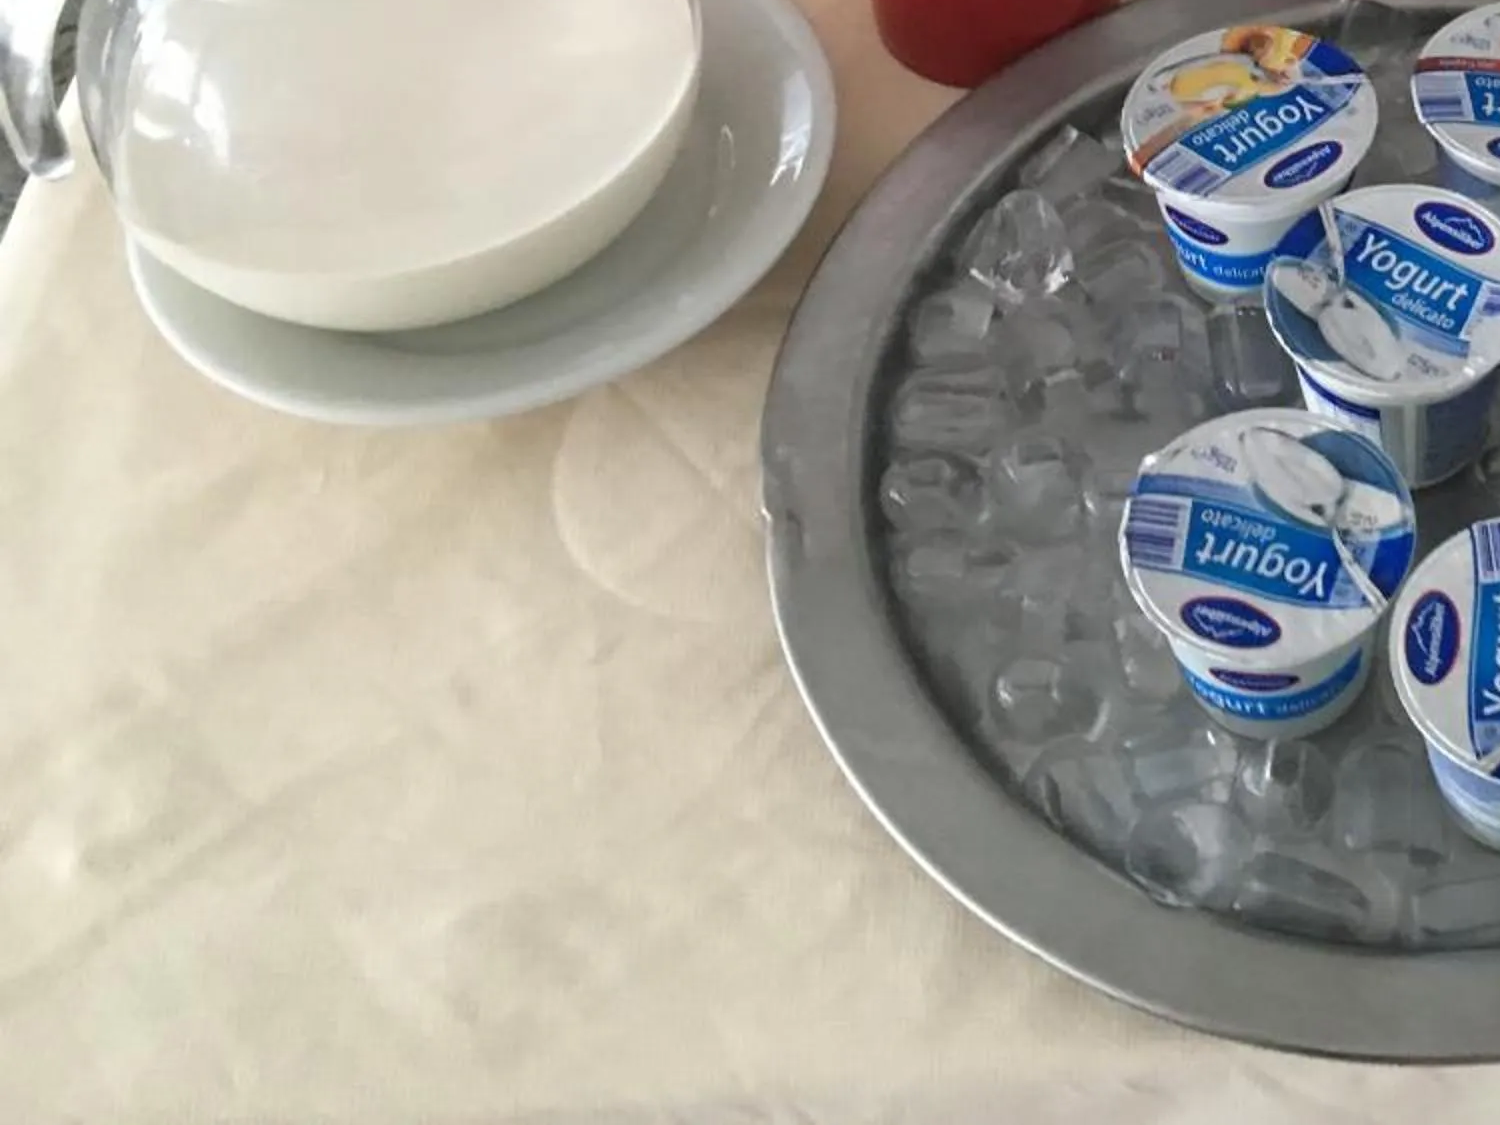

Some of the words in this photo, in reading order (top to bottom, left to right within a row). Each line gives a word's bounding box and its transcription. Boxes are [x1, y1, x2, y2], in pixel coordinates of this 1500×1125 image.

[1191, 109, 1251, 144] delicato
[1213, 94, 1324, 163] Yogurt
[1355, 234, 1469, 311] Yogurt
[1391, 292, 1455, 330] delicato
[1201, 508, 1277, 543] delicato
[1195, 533, 1328, 597] Yogurt
